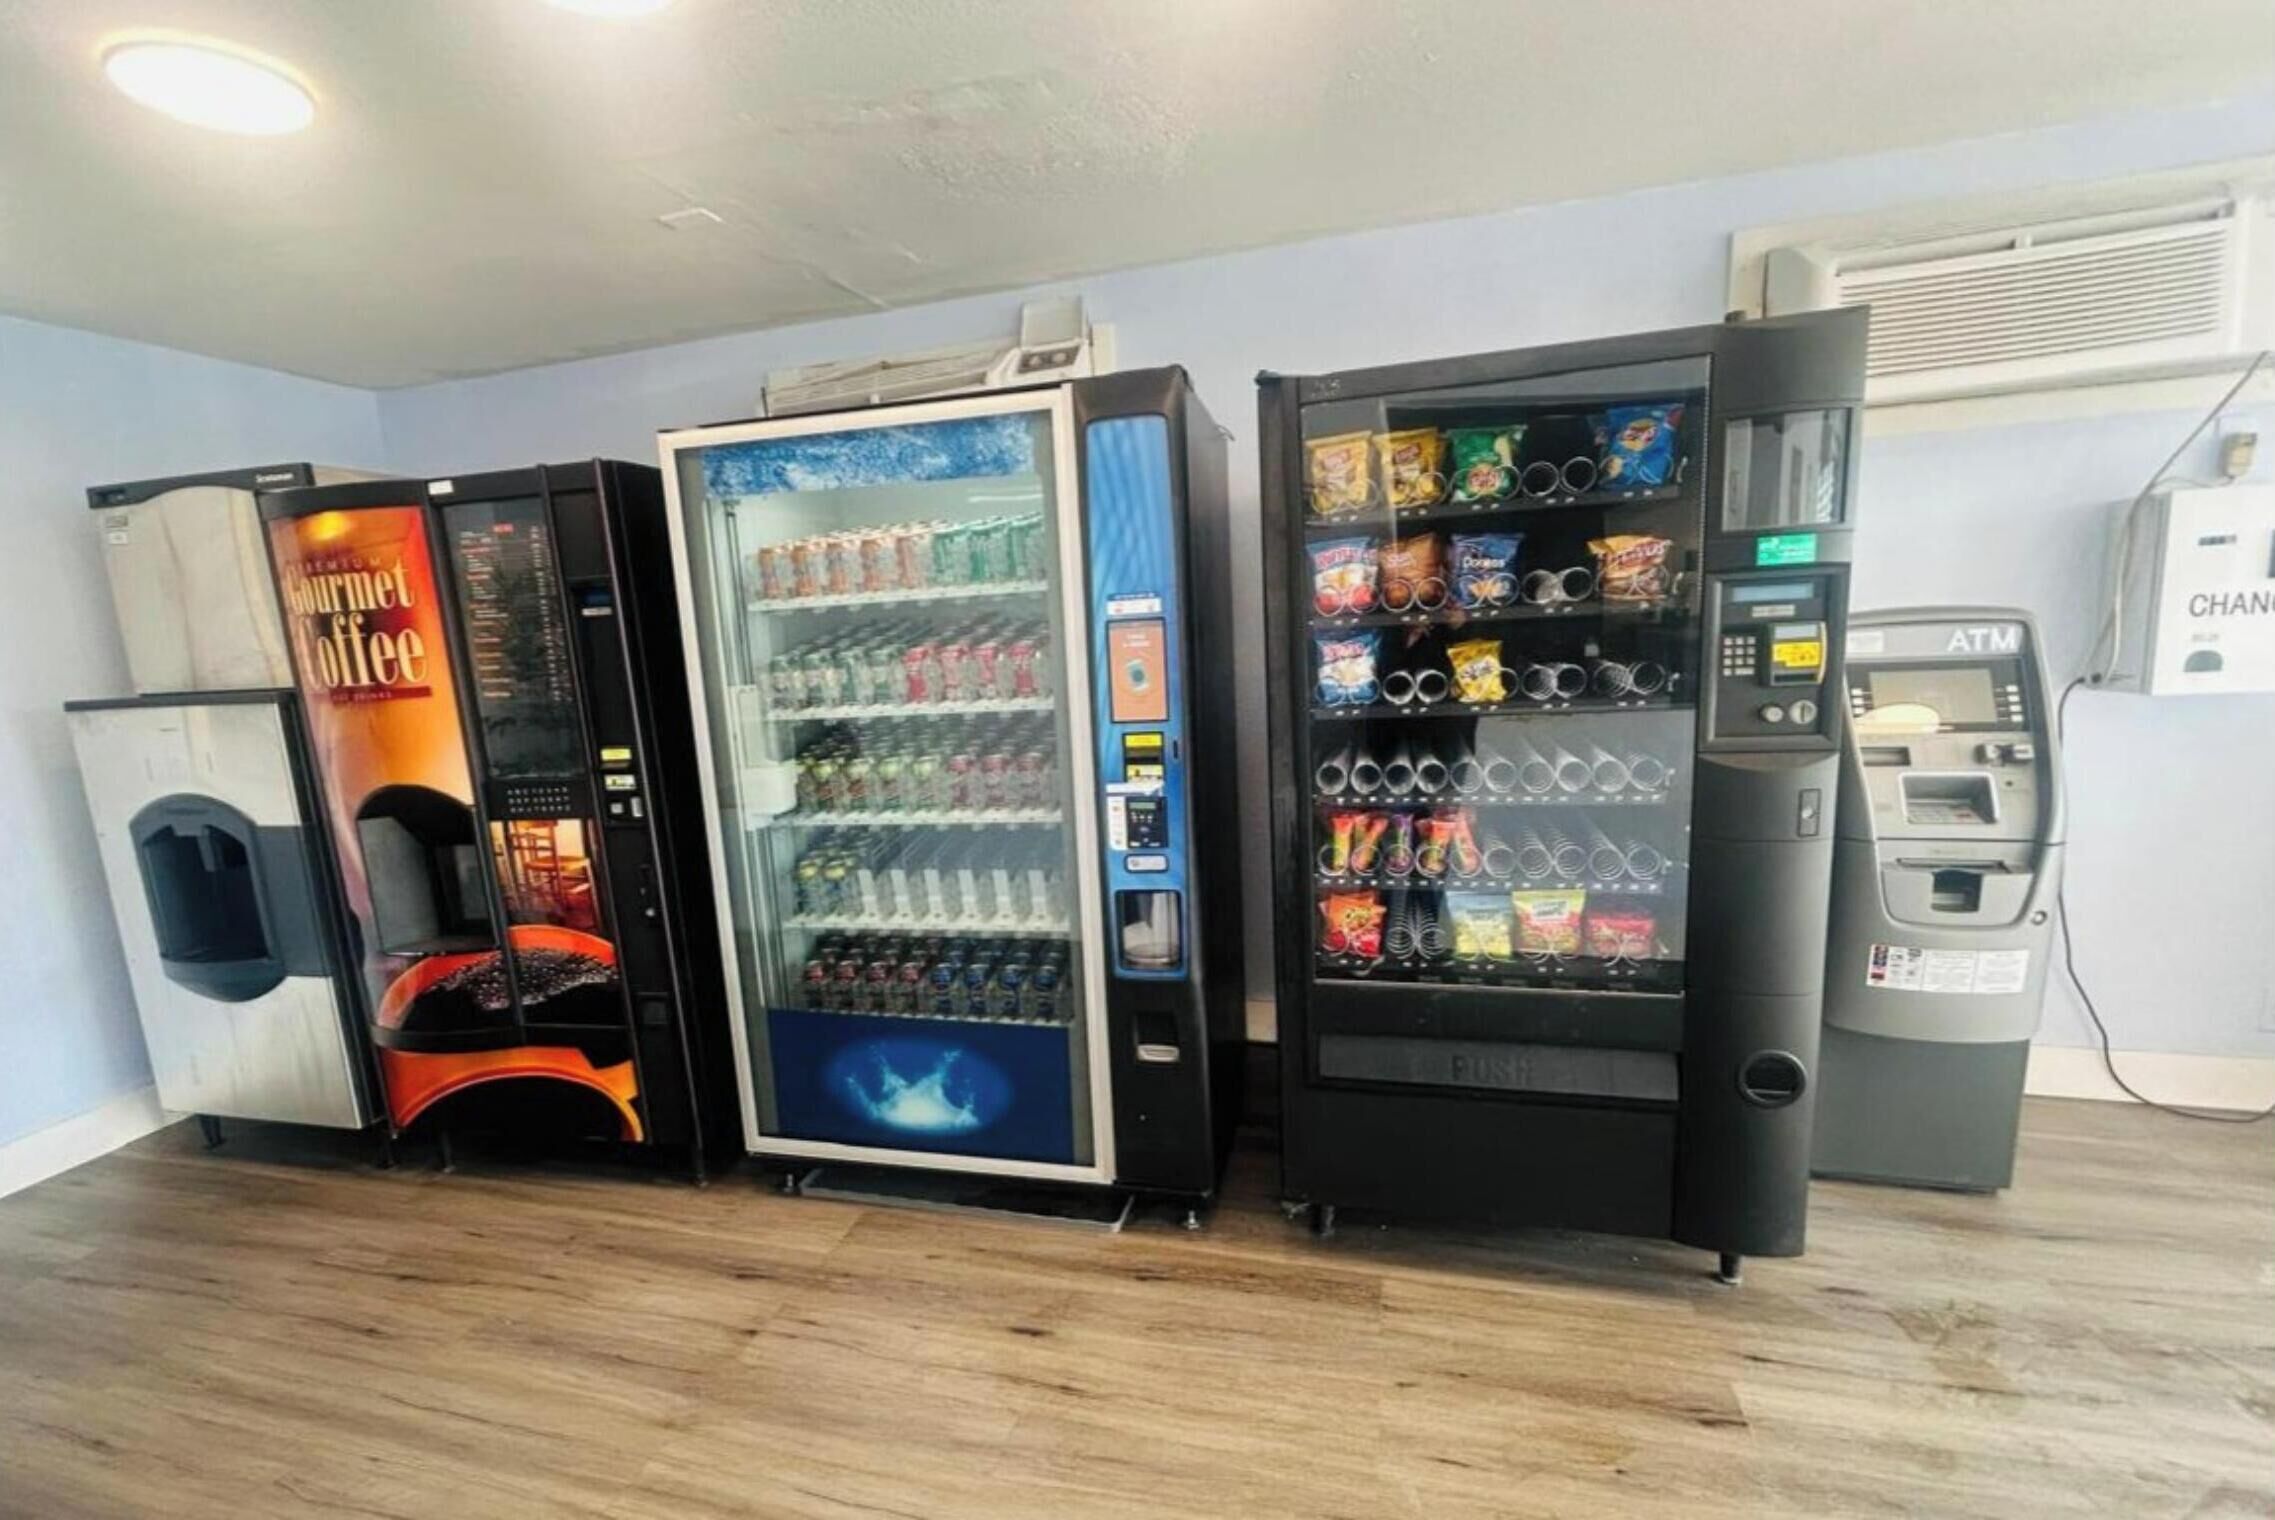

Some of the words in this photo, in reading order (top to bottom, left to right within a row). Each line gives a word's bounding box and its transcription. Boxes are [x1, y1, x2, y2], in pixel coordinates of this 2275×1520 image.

[286, 560, 415, 615] Gourmet
[2188, 590, 2275, 618] CHAN
[299, 612, 428, 689] Coffee
[1948, 627, 2016, 652] ATM
[1451, 1055, 1534, 1086] PUSH
